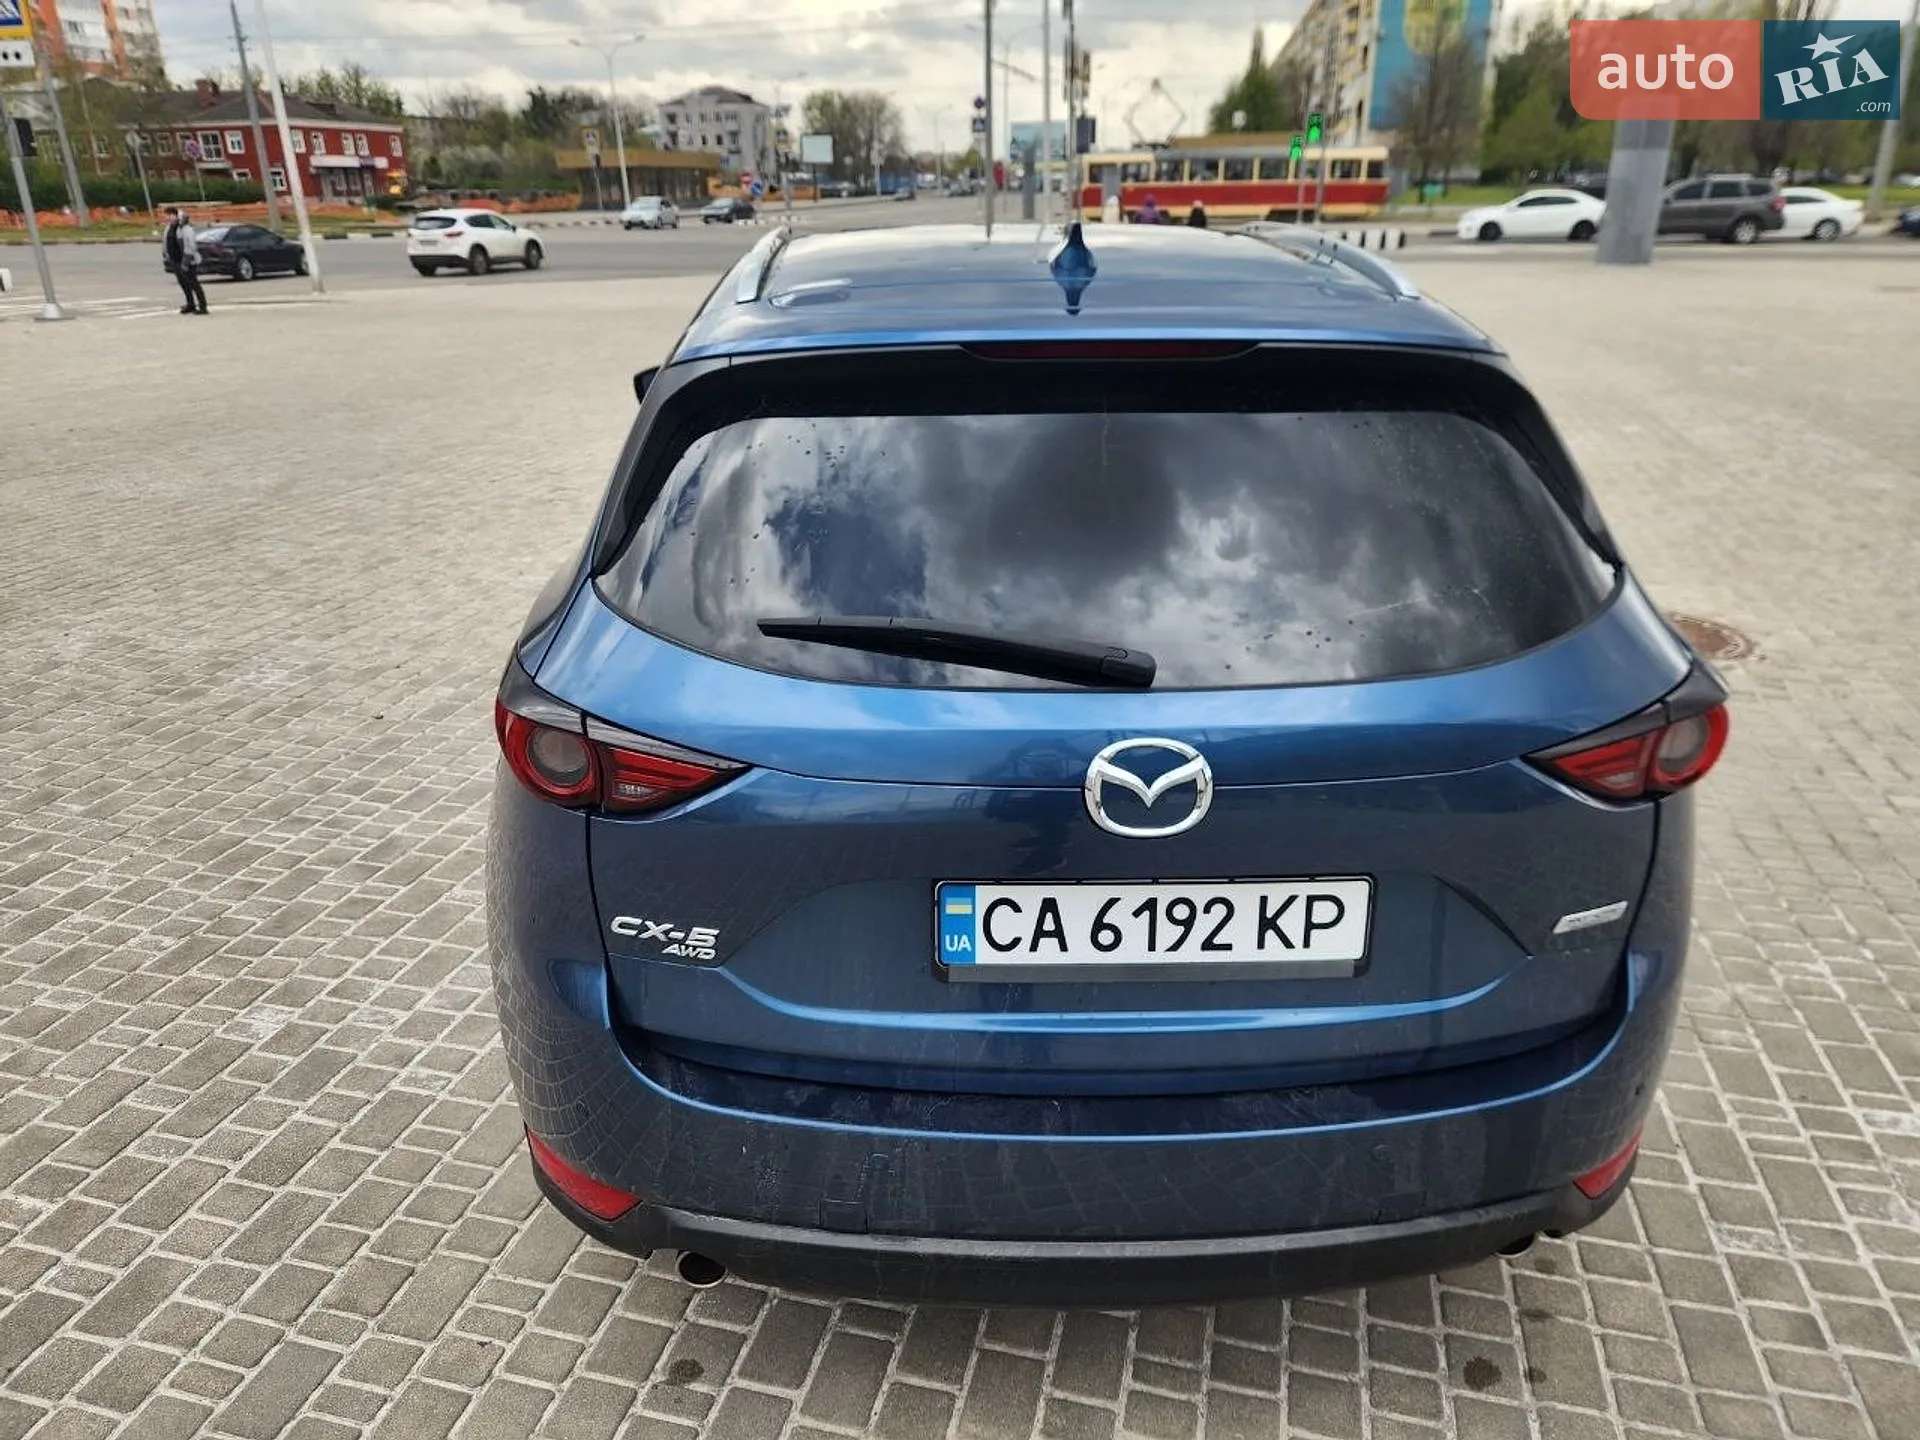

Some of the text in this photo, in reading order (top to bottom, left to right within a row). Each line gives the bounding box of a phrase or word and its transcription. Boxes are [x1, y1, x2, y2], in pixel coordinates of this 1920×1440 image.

[610, 916, 720, 948] CX-5
[983, 894, 1345, 952] CA 6192 KP
[661, 943, 716, 960] AWD
[945, 934, 972, 952] UA
